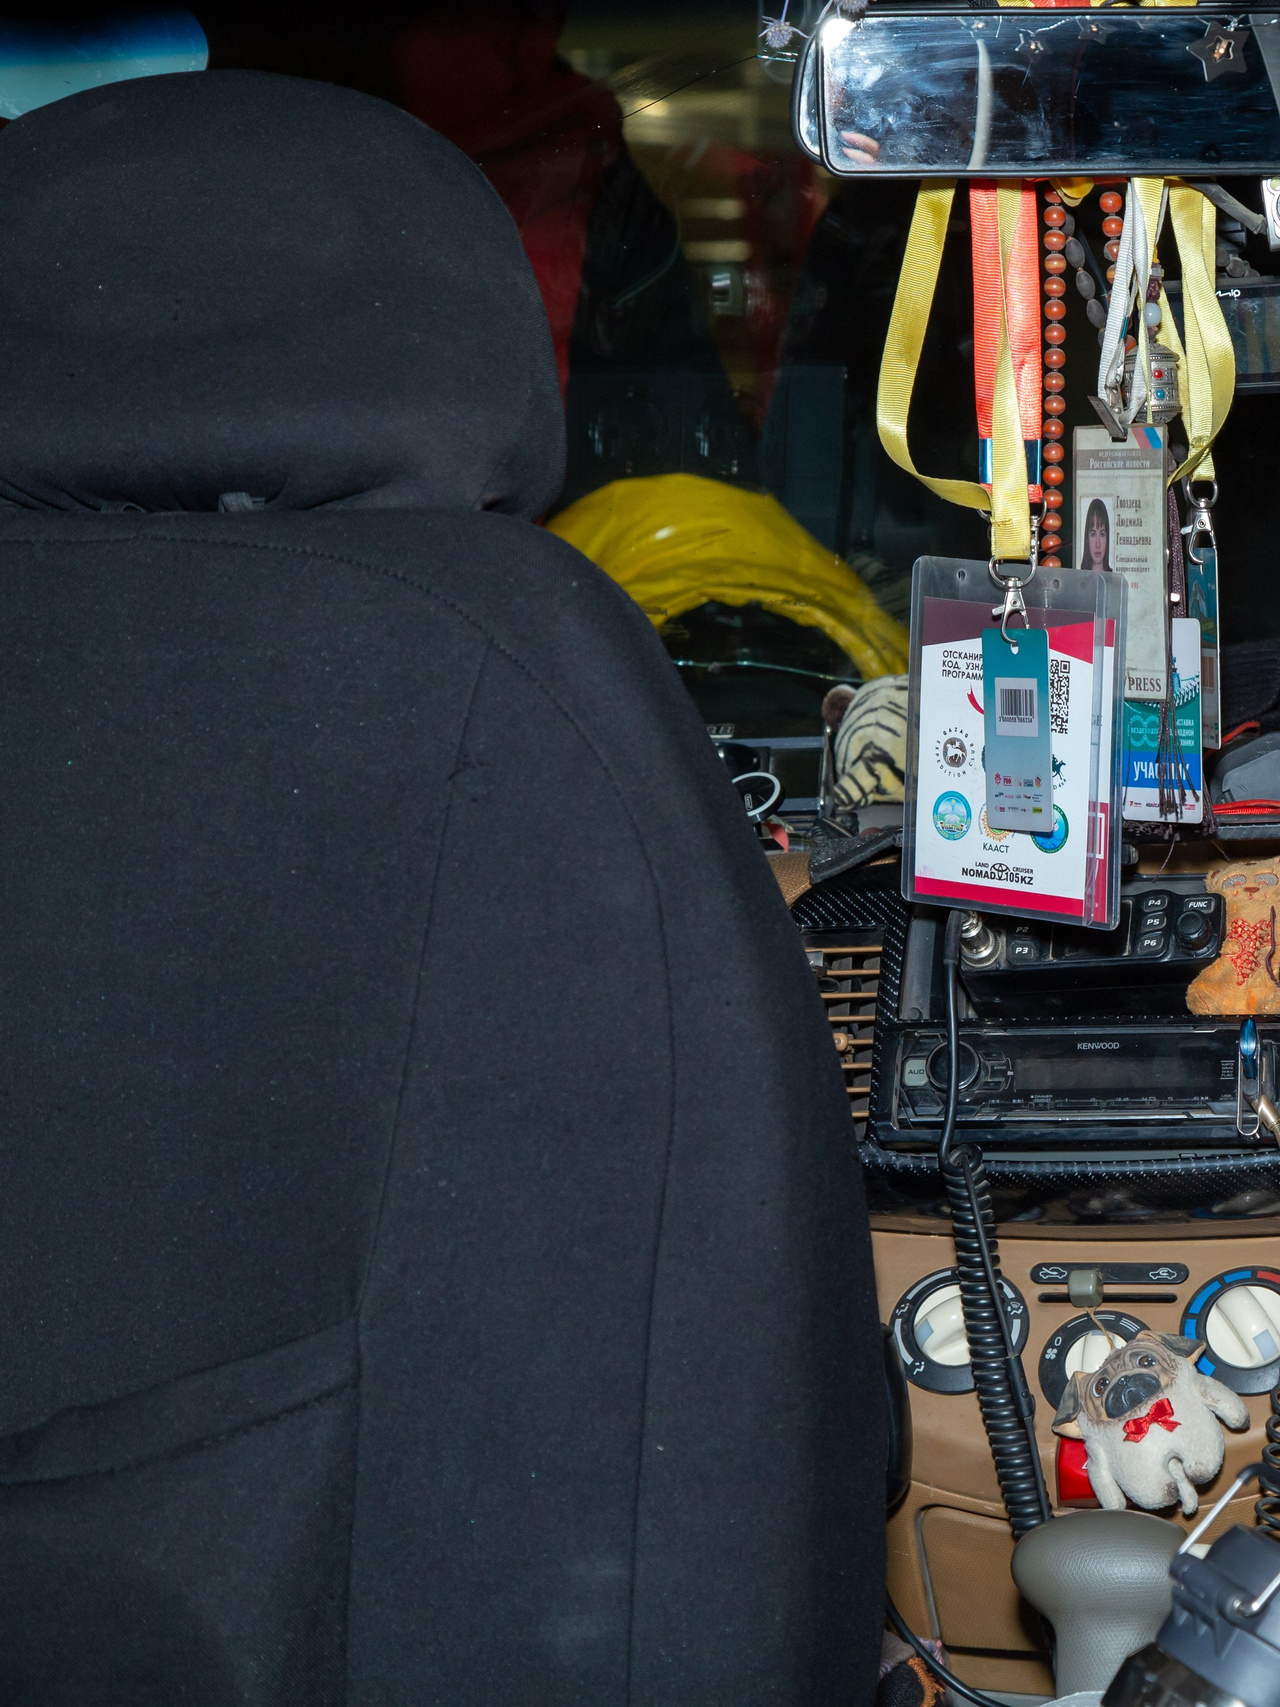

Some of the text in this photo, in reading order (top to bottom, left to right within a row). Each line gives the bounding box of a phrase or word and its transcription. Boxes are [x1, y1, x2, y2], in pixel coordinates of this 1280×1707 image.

[1089, 457, 1150, 468] Российские новости
[1116, 496, 1141, 509] Гвоздева
[1116, 514, 1142, 527] Людмила
[1116, 533, 1152, 546] Геннадьевна
[1116, 555, 1148, 564] Специальный
[942, 650, 983, 661] ОТСКАНИР
[965, 662, 983, 671] УЗНА
[942, 669, 983, 681] ПРОГРАММ
[1128, 677, 1162, 692] PRESS
[982, 842, 1009, 853] КААСТ
[961, 867, 996, 880] NOMAD
[1012, 866, 1034, 874] CRUISER
[1143, 939, 1157, 947] P6
[1077, 1042, 1120, 1050] KENWOOD
